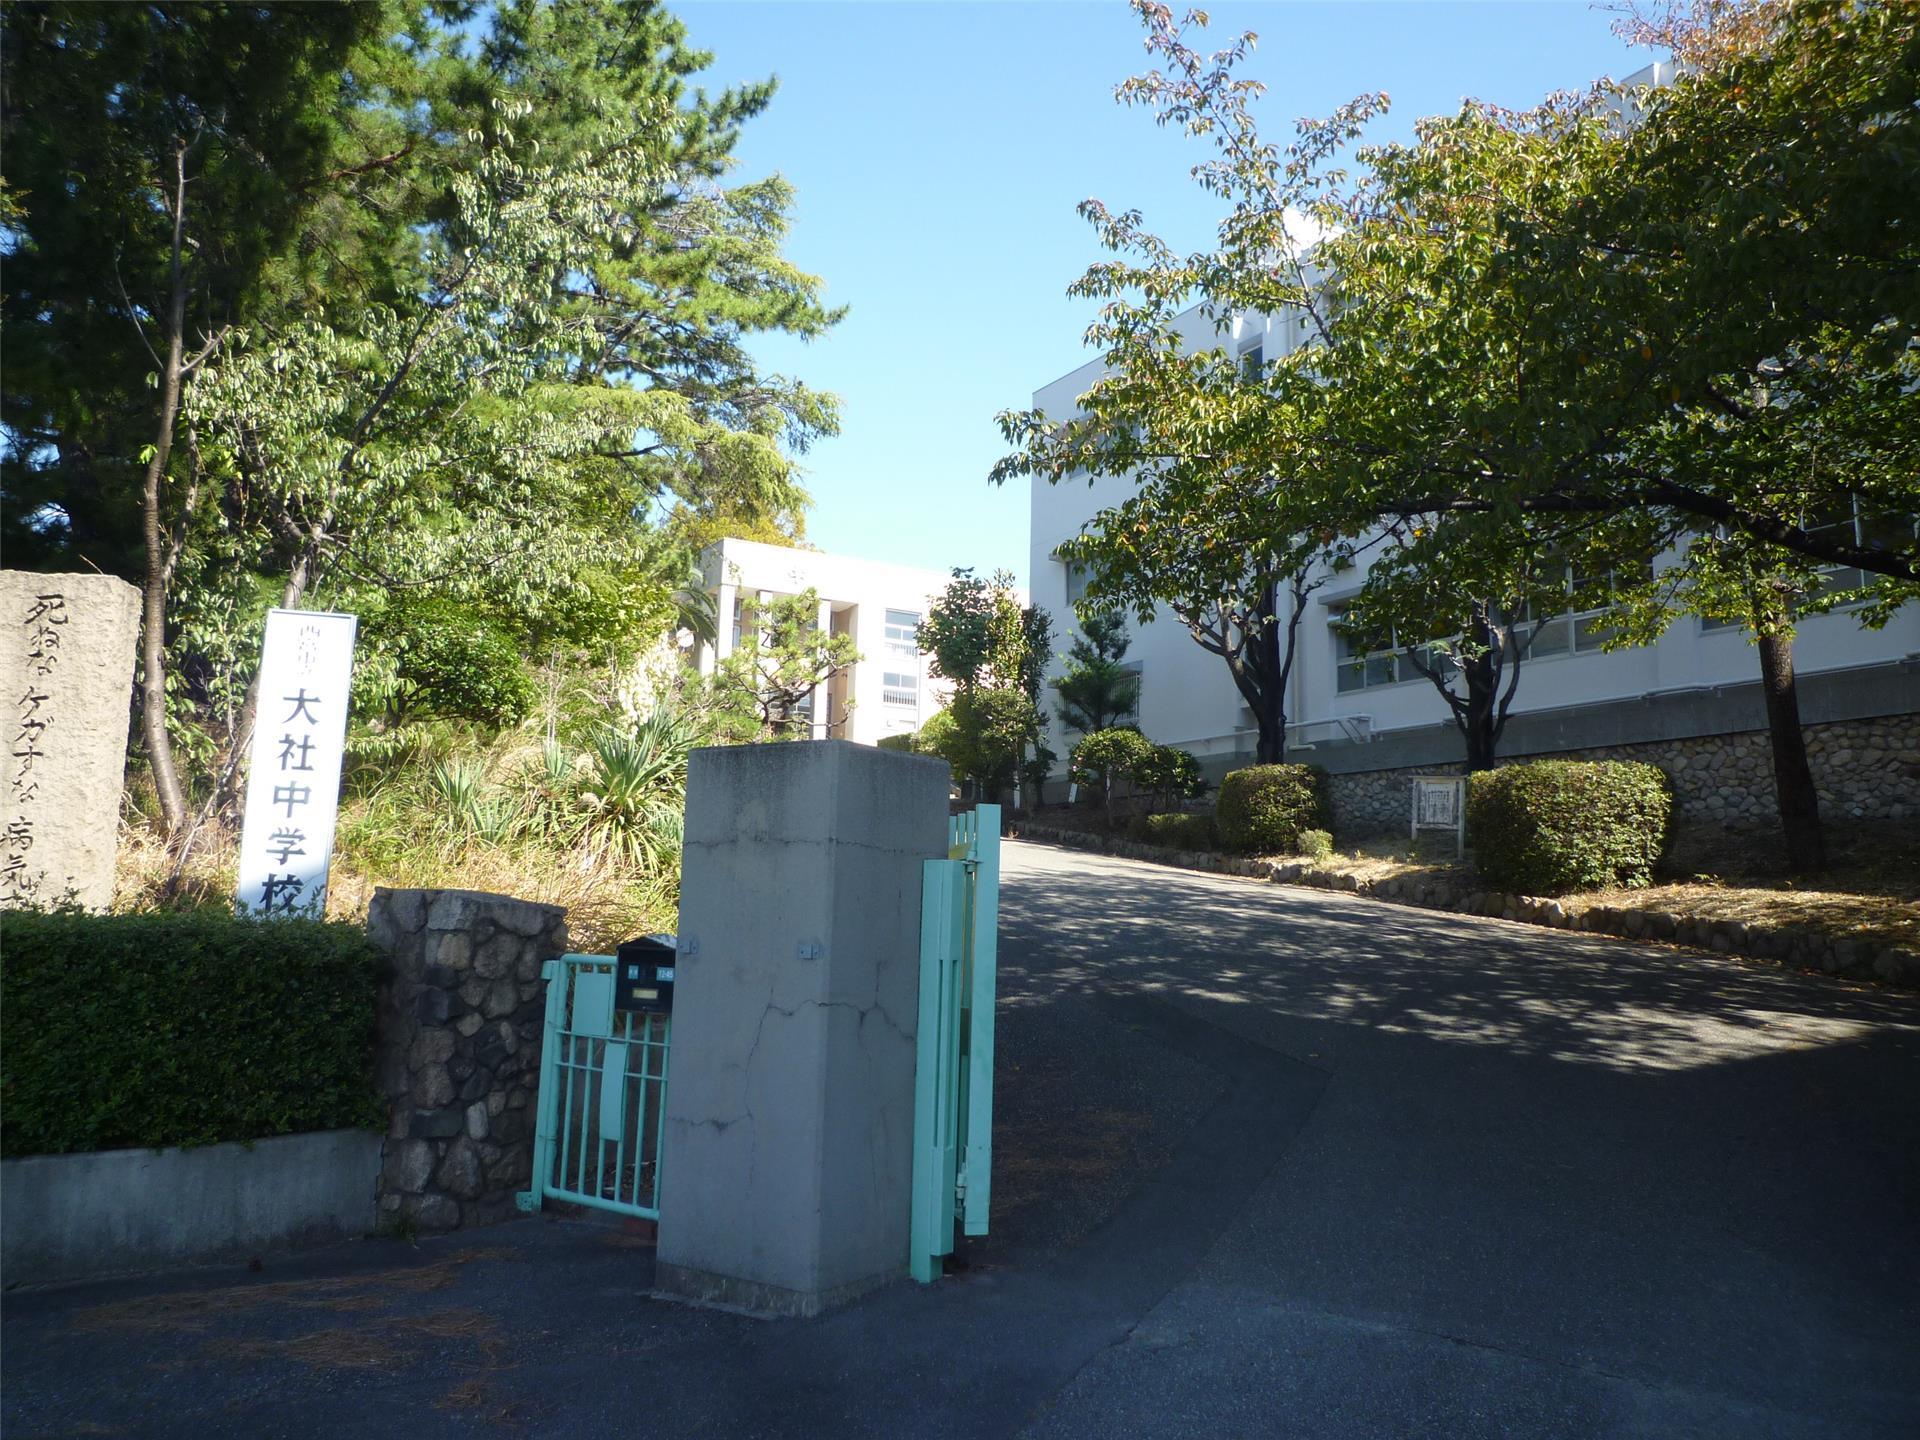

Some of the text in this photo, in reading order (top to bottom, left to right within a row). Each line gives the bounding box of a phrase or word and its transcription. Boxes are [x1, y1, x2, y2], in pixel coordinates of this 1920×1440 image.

[12, 685, 55, 804] ケガすな
[259, 688, 322, 914] 大社中学校
